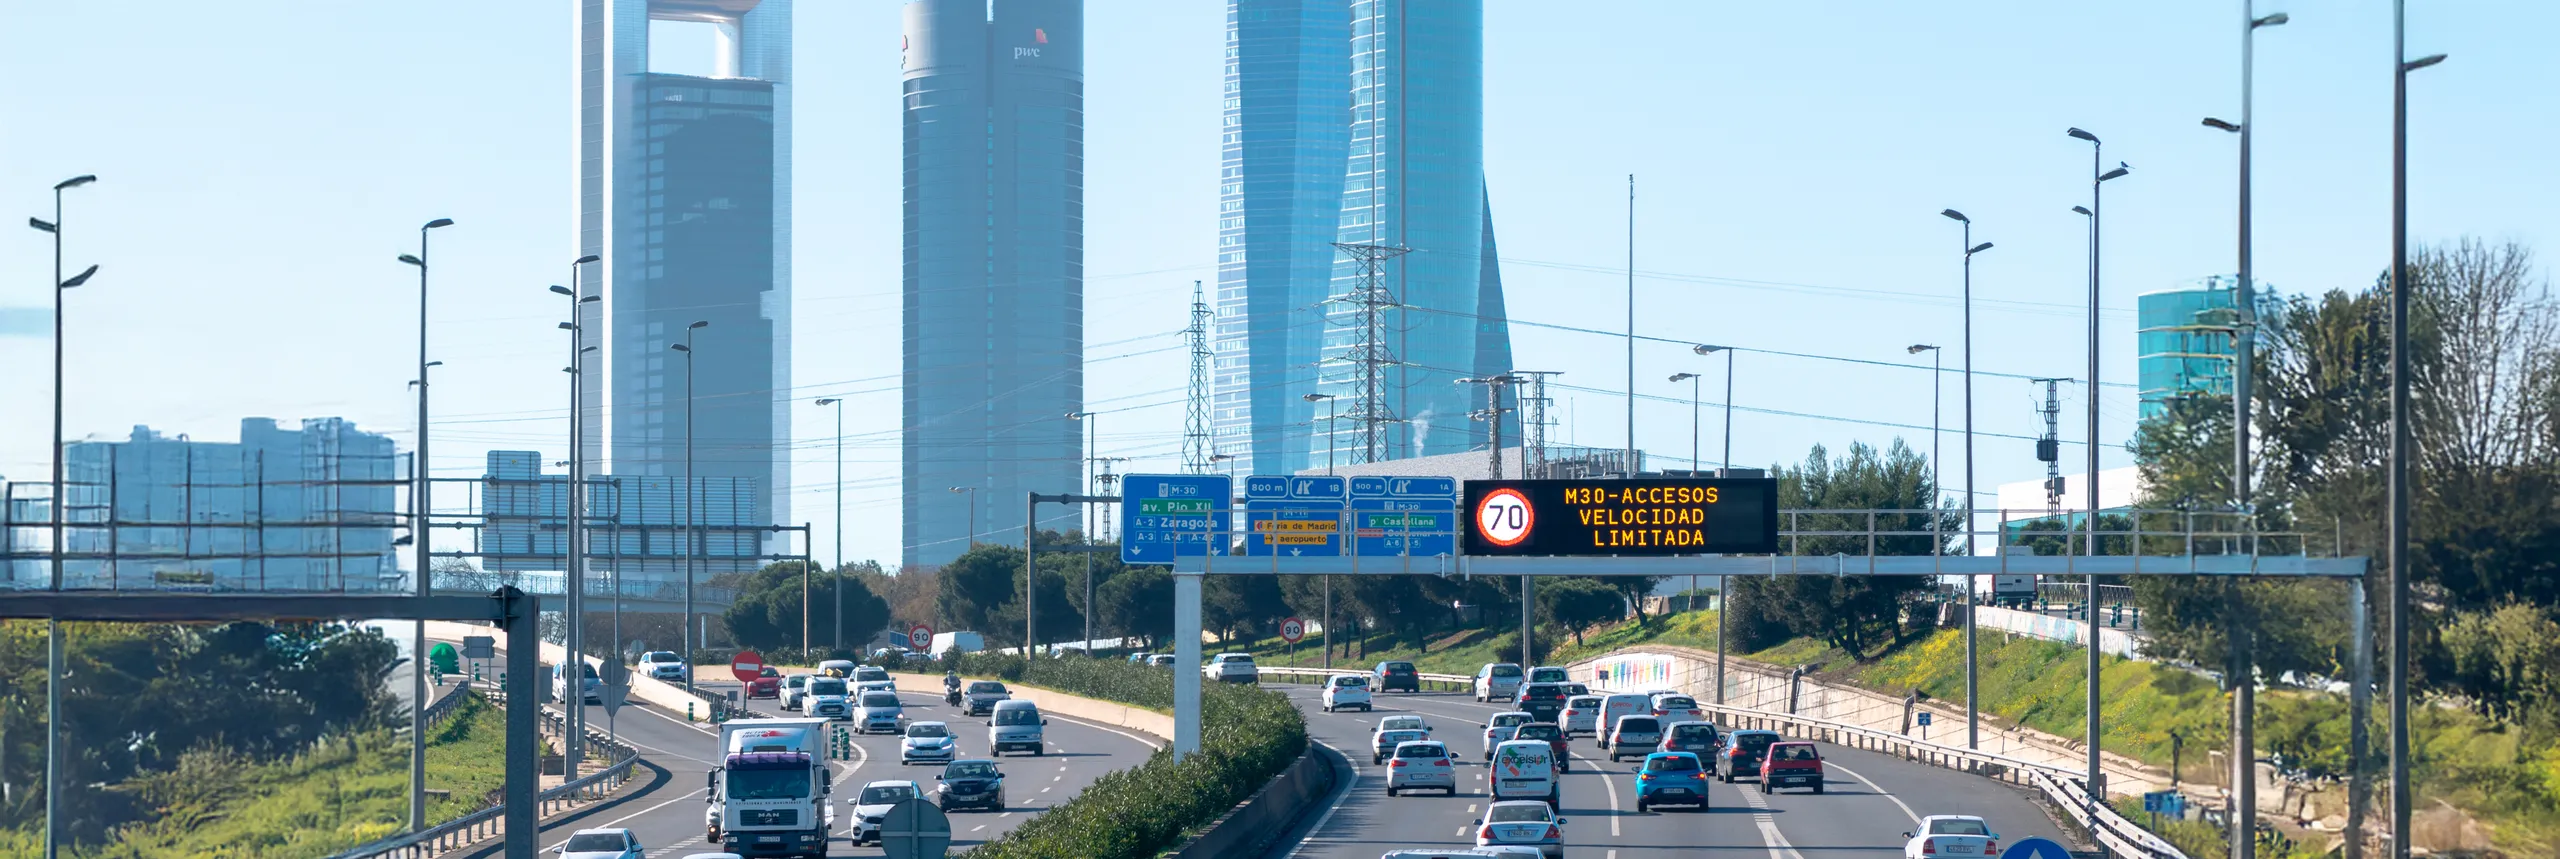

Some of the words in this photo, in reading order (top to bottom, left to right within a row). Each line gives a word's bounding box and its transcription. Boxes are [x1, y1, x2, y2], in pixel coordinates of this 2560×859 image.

[1014, 46, 1040, 59] pwc
[1171, 486, 1196, 495] M-30
[1329, 484, 1340, 492] 1B
[1565, 487, 1719, 504] M30-ACCESOS
[1142, 503, 1161, 512] av.
[1195, 502, 1212, 512] XII
[1489, 504, 1524, 530] 70
[1579, 508, 1705, 525] VELOCIDAD
[1135, 518, 1154, 527] A-2
[1267, 522, 1288, 530] Fria
[1292, 522, 1303, 530] de
[1307, 522, 1337, 530] Madrid
[1137, 533, 1154, 541] A-3
[1163, 533, 1182, 541] A-4
[1280, 535, 1327, 544] aeropuerto
[1594, 530, 1705, 546] LIMITADA
[1285, 626, 1300, 635] 90
[914, 633, 929, 642] 90
